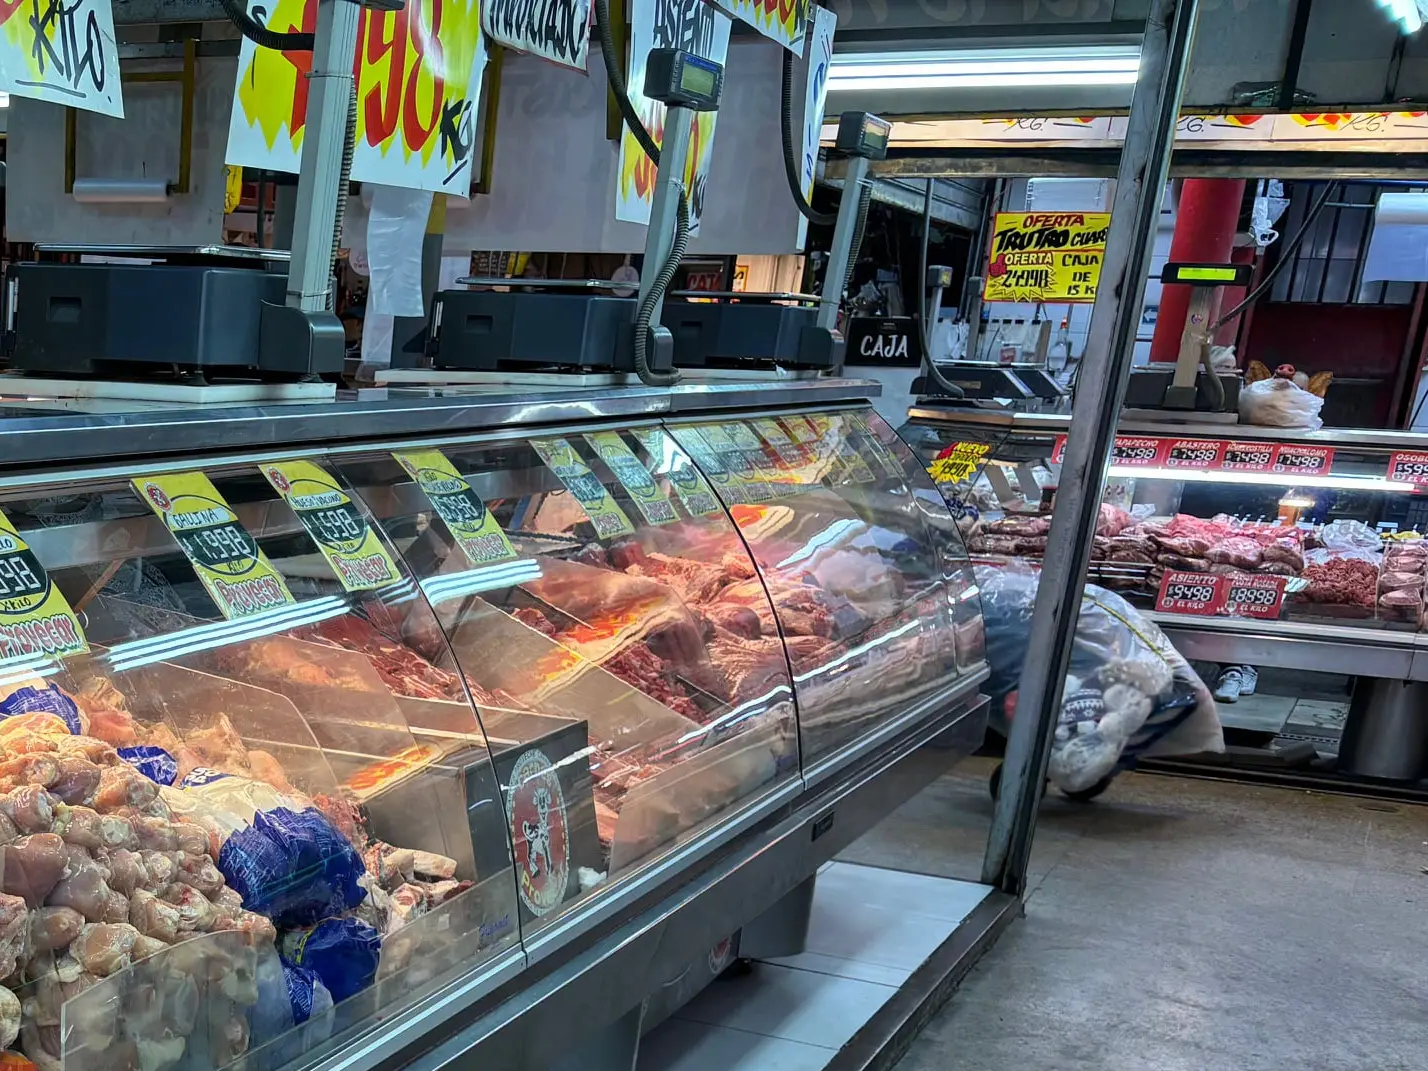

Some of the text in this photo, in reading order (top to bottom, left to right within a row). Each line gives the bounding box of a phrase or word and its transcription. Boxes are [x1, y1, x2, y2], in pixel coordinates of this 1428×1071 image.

[29, 0, 105, 92] KILO
[1023, 215, 1085, 229] OFERTA
[1005, 252, 1053, 265] OFERTA
[1062, 254, 1099, 267] CAJA
[860, 334, 909, 358] CAJA
[1174, 440, 1220, 449] ABASTERO
[172, 508, 219, 528] GALLINA
[1169, 573, 1217, 584] ASIENTO
[1168, 585, 1212, 601] $9498
[1187, 601, 1204, 609] KILO
